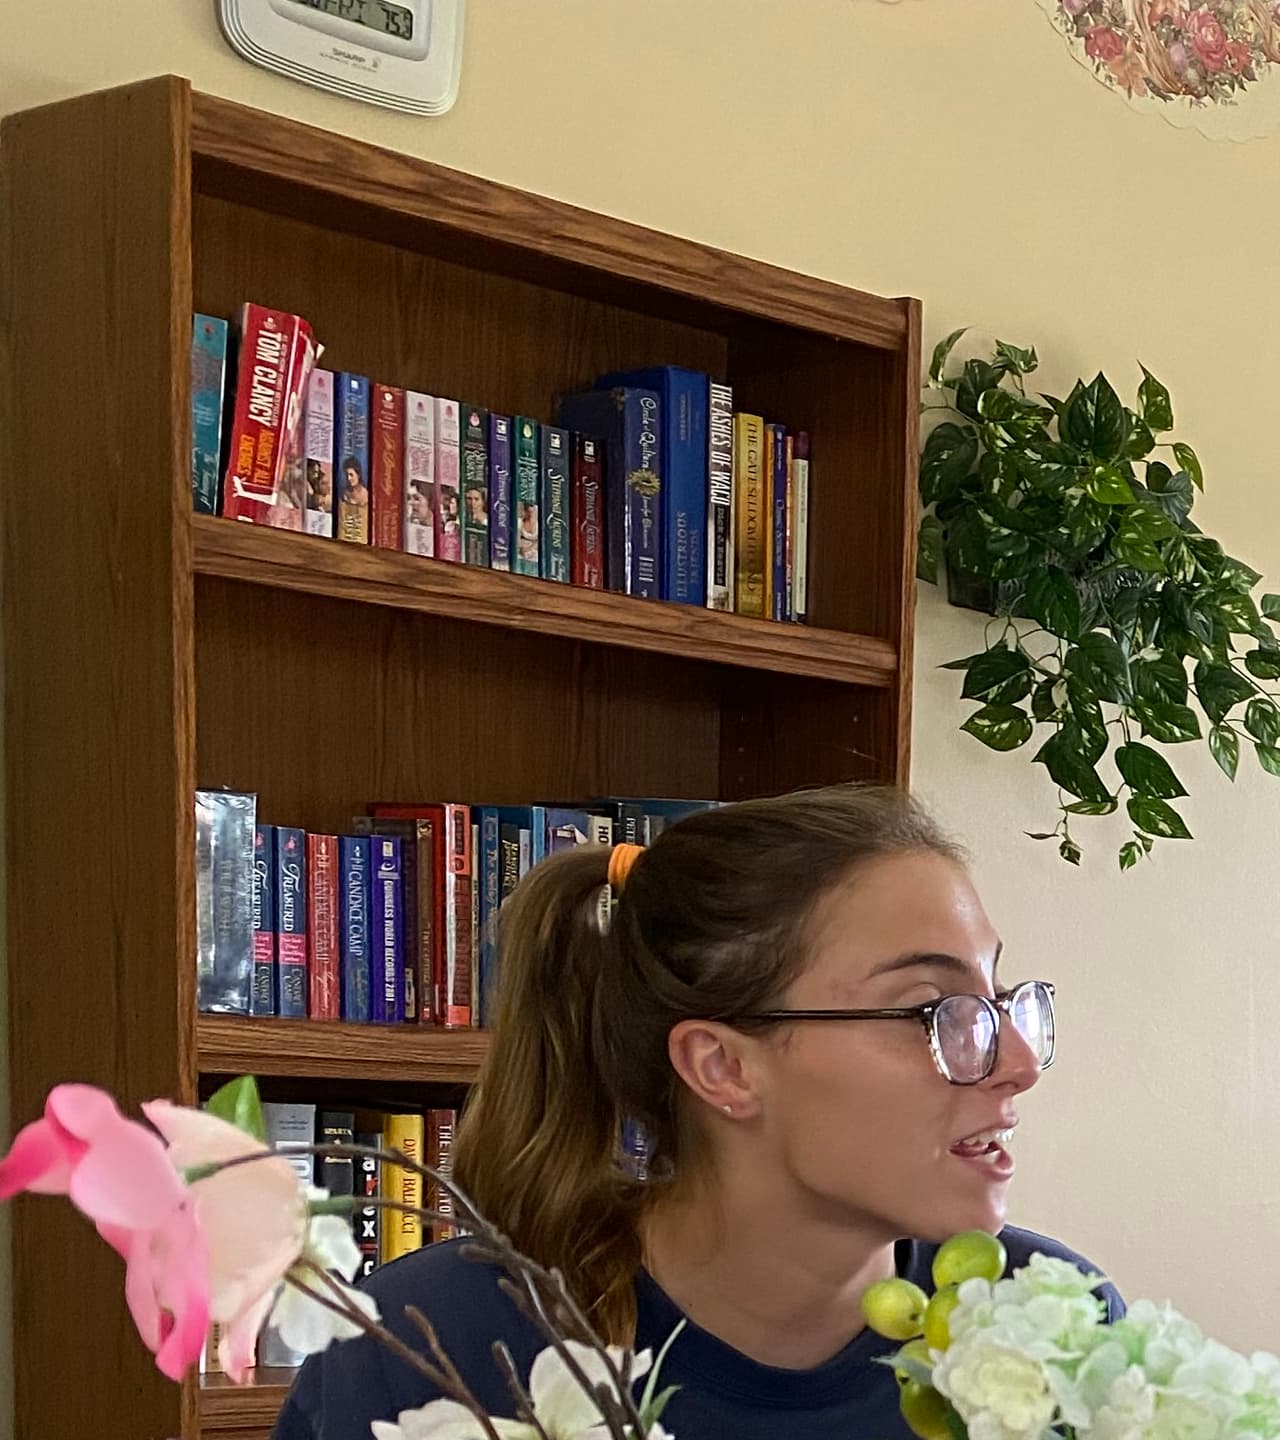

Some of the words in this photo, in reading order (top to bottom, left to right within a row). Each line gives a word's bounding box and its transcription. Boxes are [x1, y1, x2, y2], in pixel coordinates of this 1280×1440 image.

[255, 329, 282, 363] TOM
[248, 365, 279, 427] CLANCY
[640, 397, 657, 426] Circle
[711, 383, 733, 405] THE
[711, 407, 732, 447] ASHES
[747, 422, 759, 448] THE
[639, 431, 655, 470] Quilters
[712, 450, 731, 467] OF
[747, 449, 760, 485] GATE
[710, 470, 731, 506] WACO
[676, 511, 688, 598] ILLUSTRIOUS
[626, 818, 636, 844] PETE
[282, 863, 300, 931] TREASURED
[348, 871, 363, 921] CANDACE
[349, 924, 364, 957] CAMP
[384, 919, 395, 946] WORLD
[384, 947, 395, 981] RECORDS
[438, 1124, 452, 1148] THE
[402, 1138, 416, 1174] DAVD
[401, 1178, 416, 1234] BALACCI
